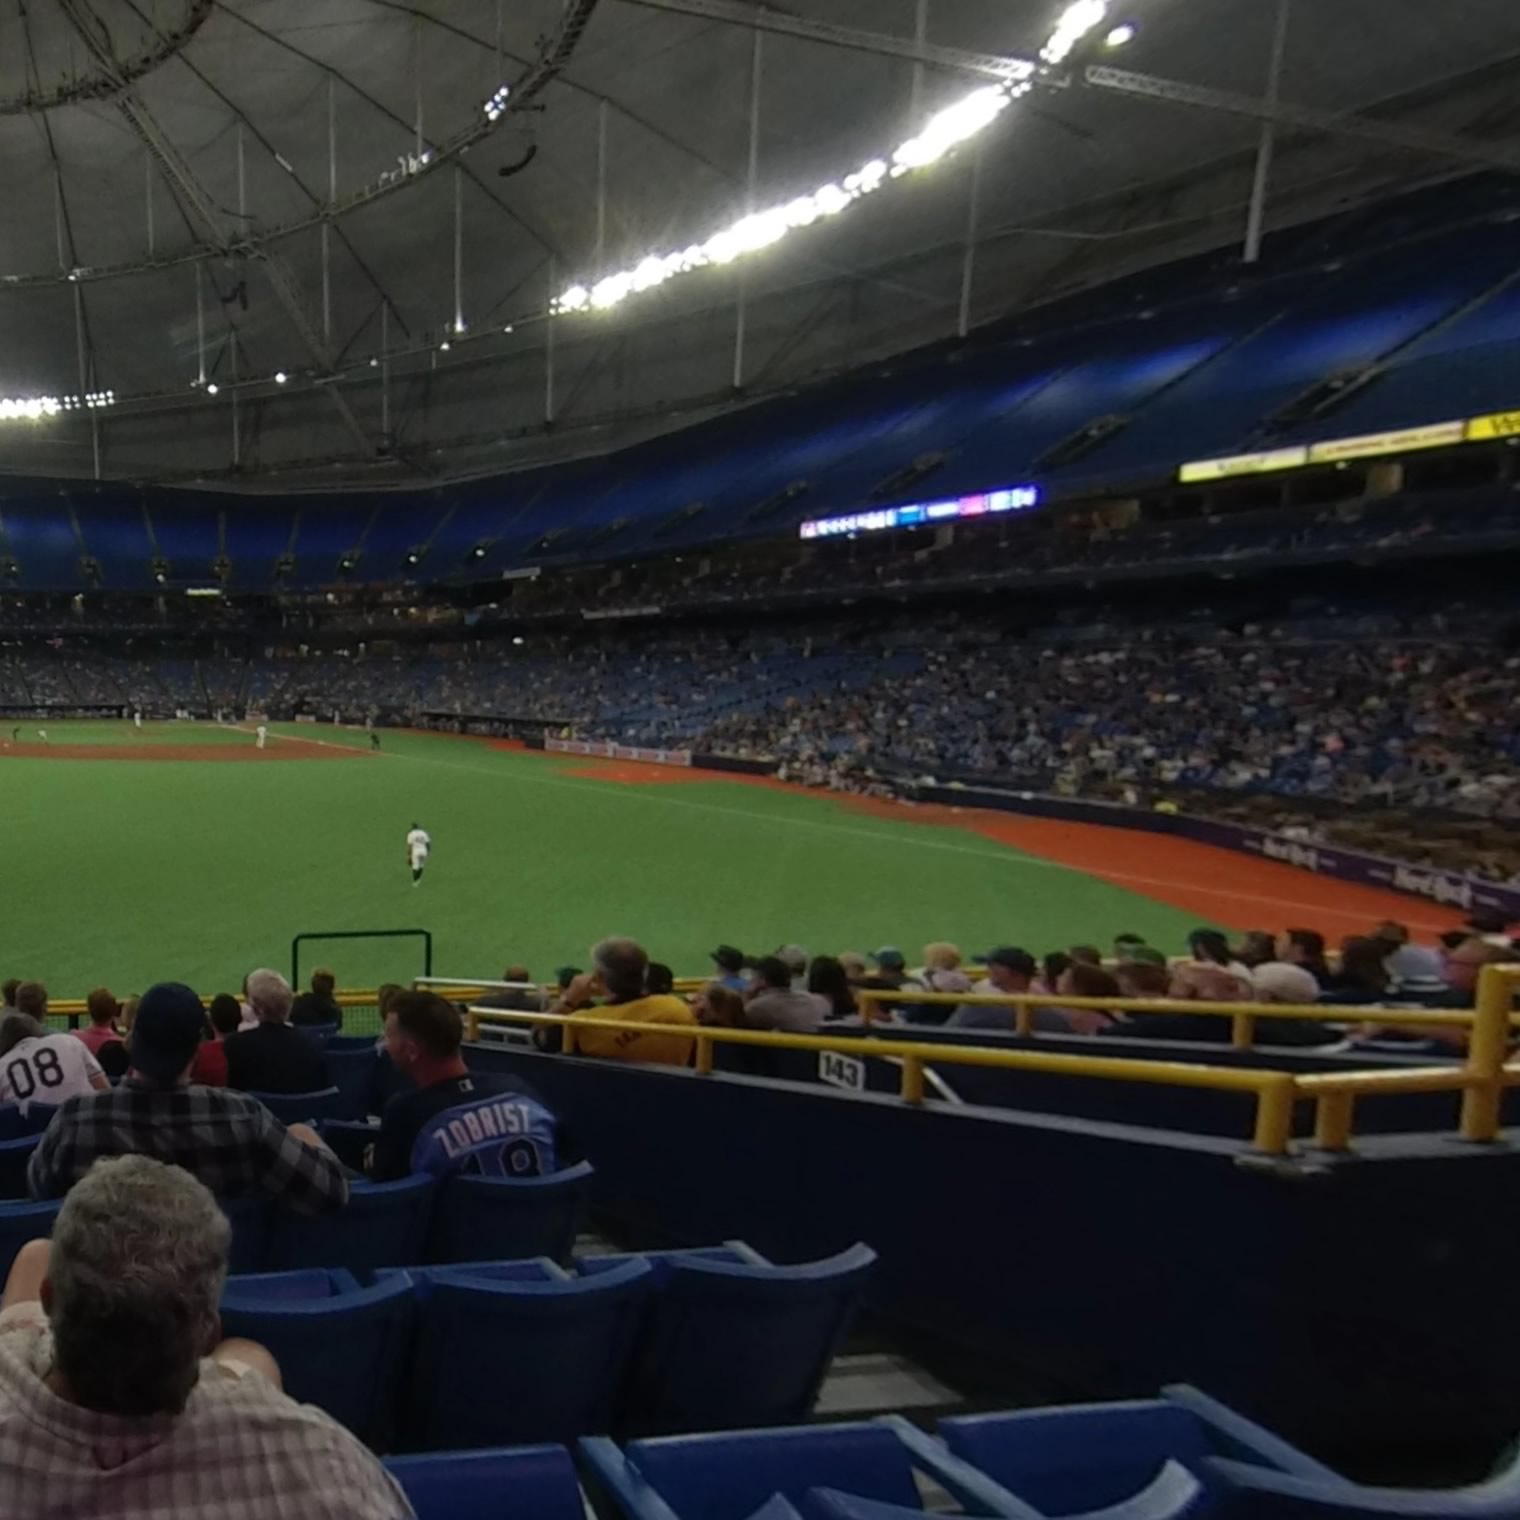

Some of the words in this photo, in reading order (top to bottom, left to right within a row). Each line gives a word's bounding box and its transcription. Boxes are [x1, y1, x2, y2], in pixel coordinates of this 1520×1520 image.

[7, 1047, 64, 1099] 08
[825, 1055, 858, 1087] 143
[432, 1103, 530, 1159] ZOBRIST
